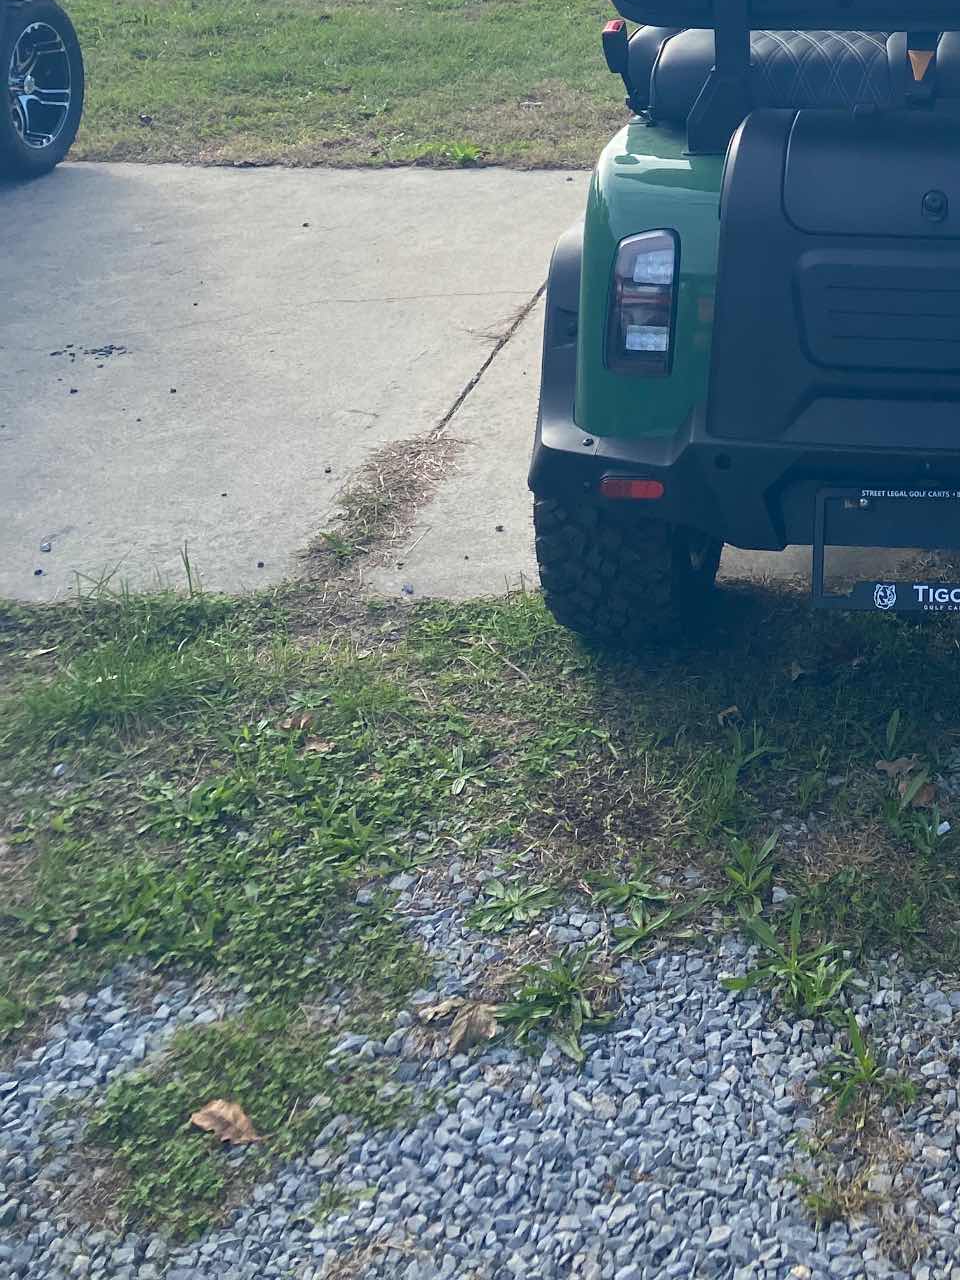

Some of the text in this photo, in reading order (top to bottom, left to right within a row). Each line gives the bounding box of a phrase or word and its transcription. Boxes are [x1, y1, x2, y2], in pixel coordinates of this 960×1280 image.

[861, 489, 886, 497] STREET
[909, 490, 926, 498] GOLF
[928, 490, 950, 498] CARTS
